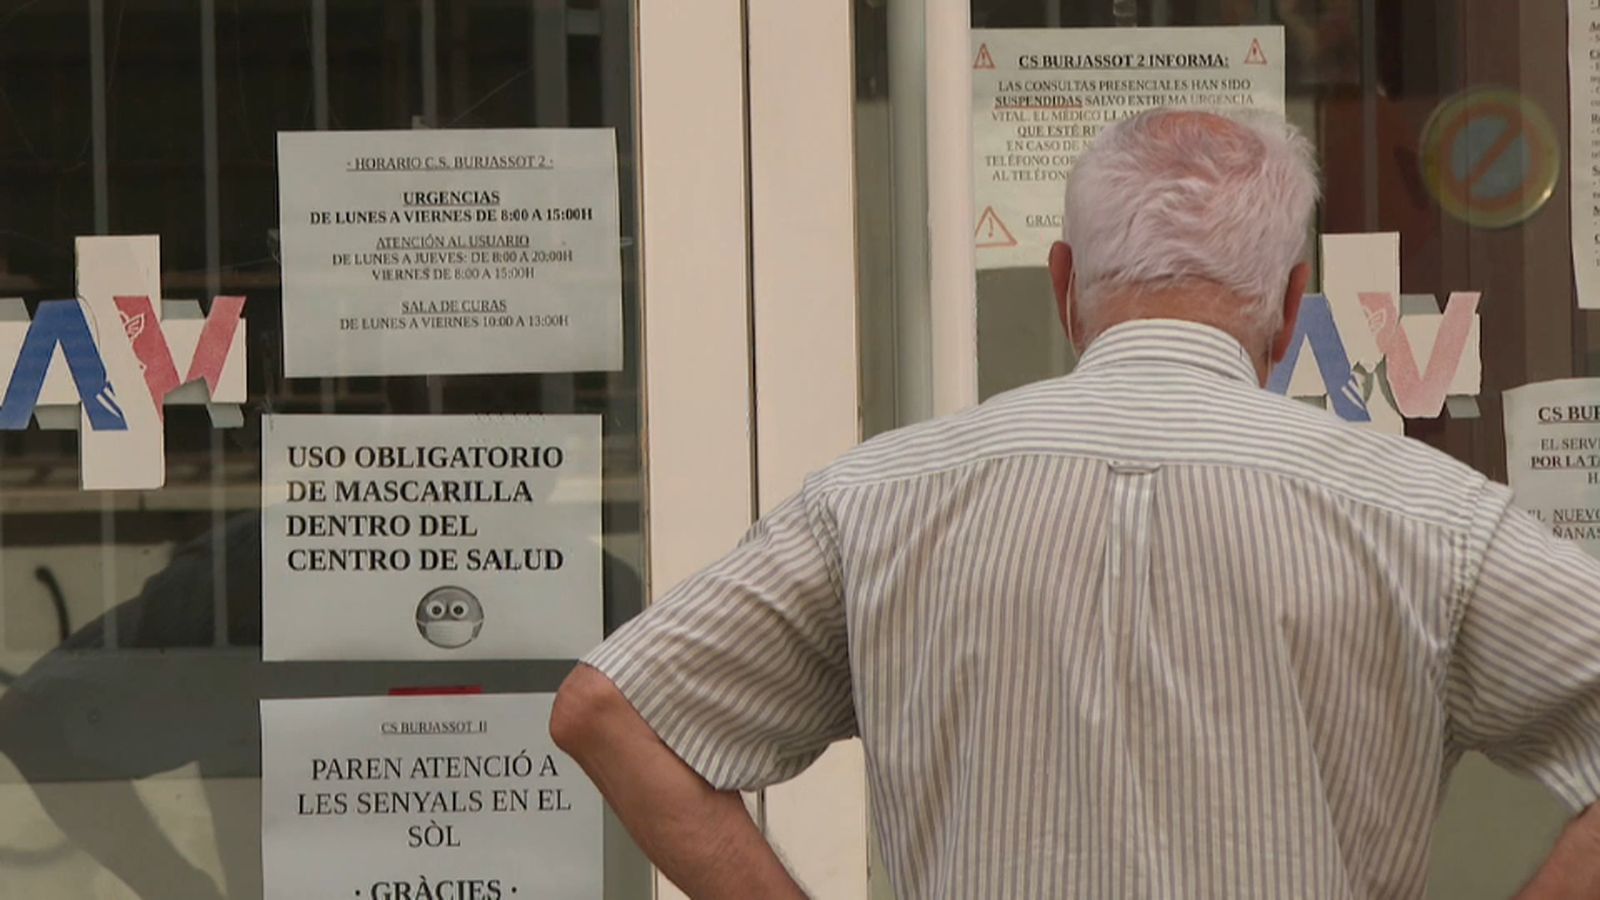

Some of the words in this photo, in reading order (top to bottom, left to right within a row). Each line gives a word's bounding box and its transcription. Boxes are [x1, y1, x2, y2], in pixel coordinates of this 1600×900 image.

[1019, 56, 1040, 68] CS
[1043, 55, 1134, 69] BURJASSOT
[1137, 55, 1145, 67] 2
[1148, 54, 1229, 68] INFORMA:
[999, 81, 1023, 92] LAS
[1025, 81, 1096, 92] CONSULTAS
[1100, 80, 1189, 91] PRESENCIALES
[1192, 80, 1219, 91] HAN
[1221, 80, 1250, 90] SIDO
[995, 96, 1083, 108] SUSPENDIDAS
[1085, 95, 1125, 106] SALVO
[1128, 95, 1187, 106] EXTREMA
[1190, 94, 1253, 105] URGENCIA
[1034, 111, 1048, 121] EL
[1052, 109, 1101, 121] MÉDICO
[1018, 125, 1045, 138] QUE
[1047, 124, 1080, 137] ESTÉ
[1007, 141, 1025, 151] EN
[1026, 140, 1061, 150] CASO
[1063, 140, 1080, 150] DE
[355, 158, 422, 171] HORARIO
[425, 158, 447, 170] C.S.
[454, 157, 535, 169] BURJASSOT
[537, 157, 545, 168] 2
[986, 154, 1050, 167] TELÉFONO
[992, 171, 1010, 181] AL
[403, 191, 500, 205] URGENCIAS
[310, 213, 331, 225] DE
[335, 211, 386, 224] LUNES
[389, 212, 400, 223] A
[404, 210, 471, 223] VIERNES
[475, 210, 496, 222] DE
[501, 210, 528, 222] 8:00
[532, 209, 543, 221] A
[546, 208, 592, 221] 15:00H
[376, 234, 444, 250] ATENCIÓN
[449, 236, 467, 248] AL
[469, 236, 529, 248] USUARIO
[332, 253, 351, 265] DE
[354, 252, 398, 265] LUNES
[402, 253, 413, 263] A
[415, 252, 466, 264] JUEVES:
[471, 252, 490, 263] DE
[493, 251, 516, 262] 8:00
[520, 251, 530, 262] A
[532, 250, 573, 261] 20:00H
[372, 269, 430, 281] VIERNES
[433, 268, 451, 280] DE
[454, 268, 479, 279] 8:00
[482, 268, 492, 279] A
[495, 267, 534, 279] 15:00H
[402, 301, 437, 313] SALA
[440, 302, 459, 313] DE
[462, 300, 507, 313] CURAS
[340, 319, 359, 330] DE
[363, 318, 406, 330] LUNES
[409, 318, 420, 329] A
[422, 317, 479, 328] VIERNES
[483, 316, 513, 327] 10:00
[516, 316, 526, 327] A
[528, 316, 568, 327] 13:00H
[1538, 406, 1562, 423] CS
[1541, 439, 1559, 450] EL
[287, 447, 345, 468] USO
[355, 446, 563, 468] OBLIGATORIO
[1531, 456, 1561, 470] POR
[1566, 456, 1585, 468] LA
[287, 481, 326, 502] DE
[335, 480, 533, 502] MASCARILLA
[287, 515, 410, 537] DENTRO
[419, 515, 477, 536] DEL
[288, 549, 410, 571] CENTRO
[419, 549, 457, 571] DE
[467, 549, 563, 571] SALUD
[381, 722, 397, 734] CS
[401, 721, 472, 734] BURJASSOT
[312, 758, 402, 780] PAREN
[411, 749, 532, 779] ATENCIÓ
[540, 755, 558, 776] A
[298, 793, 348, 814] LES
[357, 791, 483, 813] SENYALS
[492, 790, 528, 811] EN
[538, 789, 571, 810] EL
[408, 820, 460, 847] SÒL
[371, 875, 501, 900] GRÀCIES
